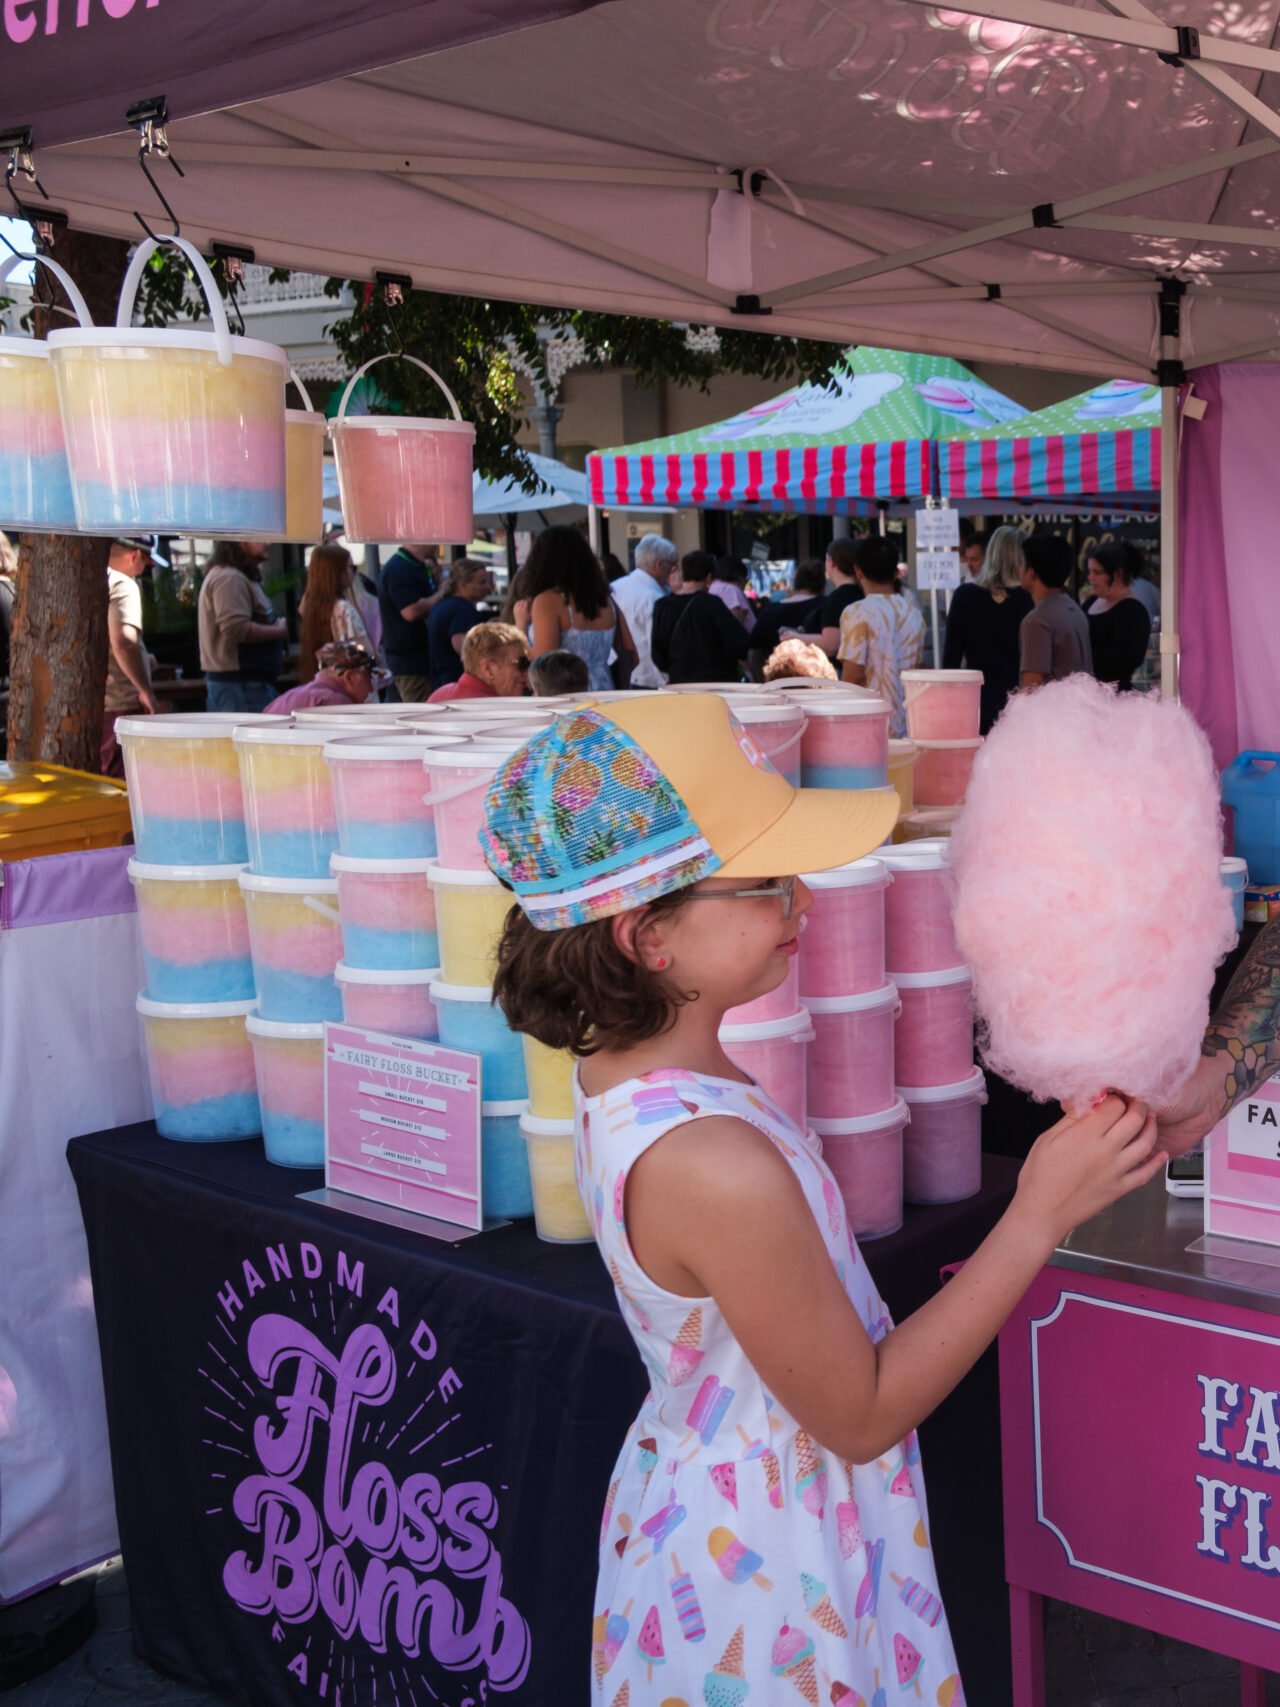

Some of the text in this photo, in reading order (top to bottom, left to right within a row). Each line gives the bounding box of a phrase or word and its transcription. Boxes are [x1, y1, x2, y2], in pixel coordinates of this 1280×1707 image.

[346, 1050, 458, 1086] FAIRY FLOSS BUCKET
[399, 1094, 415, 1103] BUCKET
[216, 1242, 463, 1404] HANDMADE
[247, 1313, 499, 1580] Floss
[222, 1474, 532, 1692] Bomb
